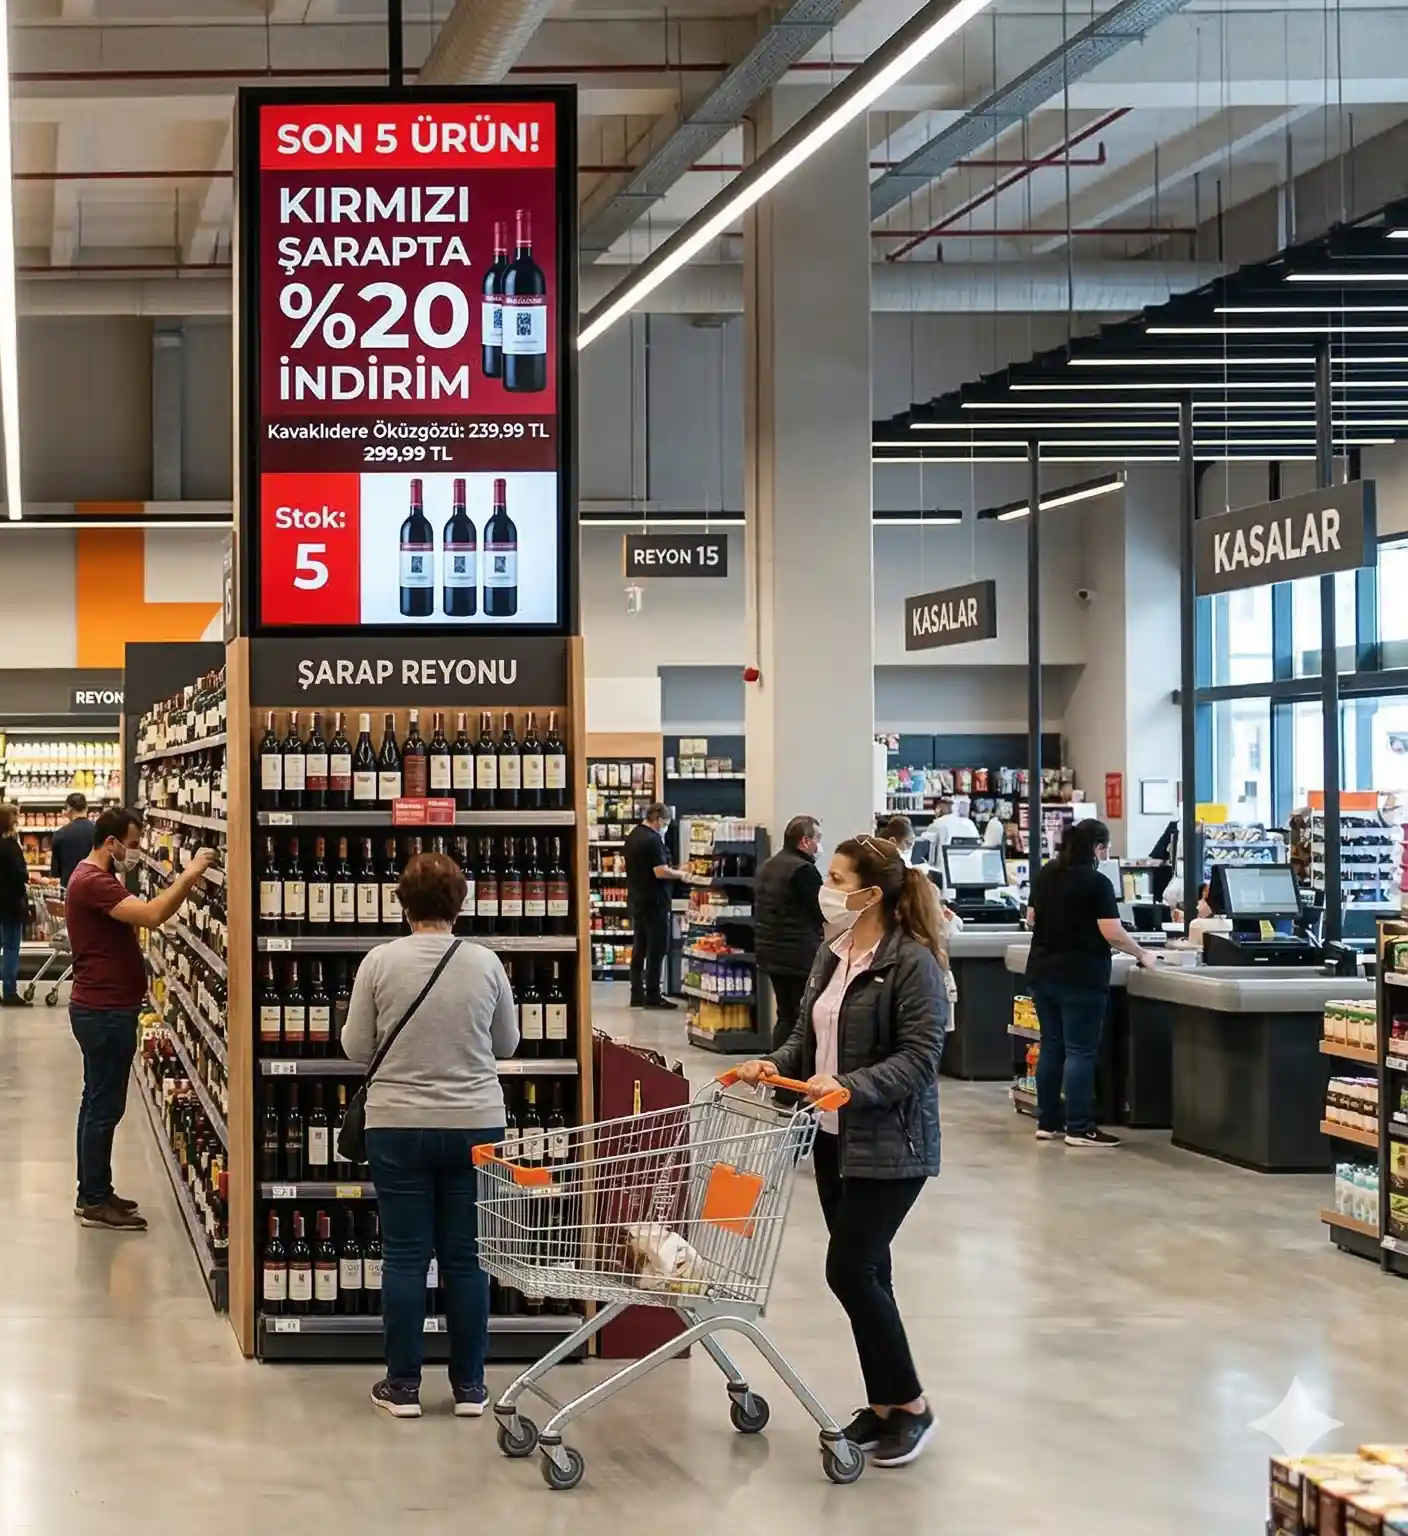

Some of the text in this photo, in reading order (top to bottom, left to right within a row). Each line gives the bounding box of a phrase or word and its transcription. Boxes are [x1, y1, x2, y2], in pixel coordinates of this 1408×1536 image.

[277, 114, 541, 155] SON 5 ÜRÜN!
[280, 186, 469, 224] KIRMIZI
[277, 236, 472, 276] ŞARAPTA
[279, 281, 470, 350] %20
[279, 355, 470, 401] İNDİRİM
[267, 423, 369, 440] Kavaklıdere
[373, 420, 465, 442] Öküzgözü:
[528, 423, 551, 439] TL
[430, 446, 454, 462] TL
[275, 505, 347, 530] Stok:
[633, 545, 720, 566] REYON 15
[1213, 508, 1342, 575] KASALAR
[293, 543, 330, 591] 5
[912, 597, 979, 637] KASALAR
[297, 659, 518, 690] ŞARAP REYONU
[75, 690, 125, 704] REYON
